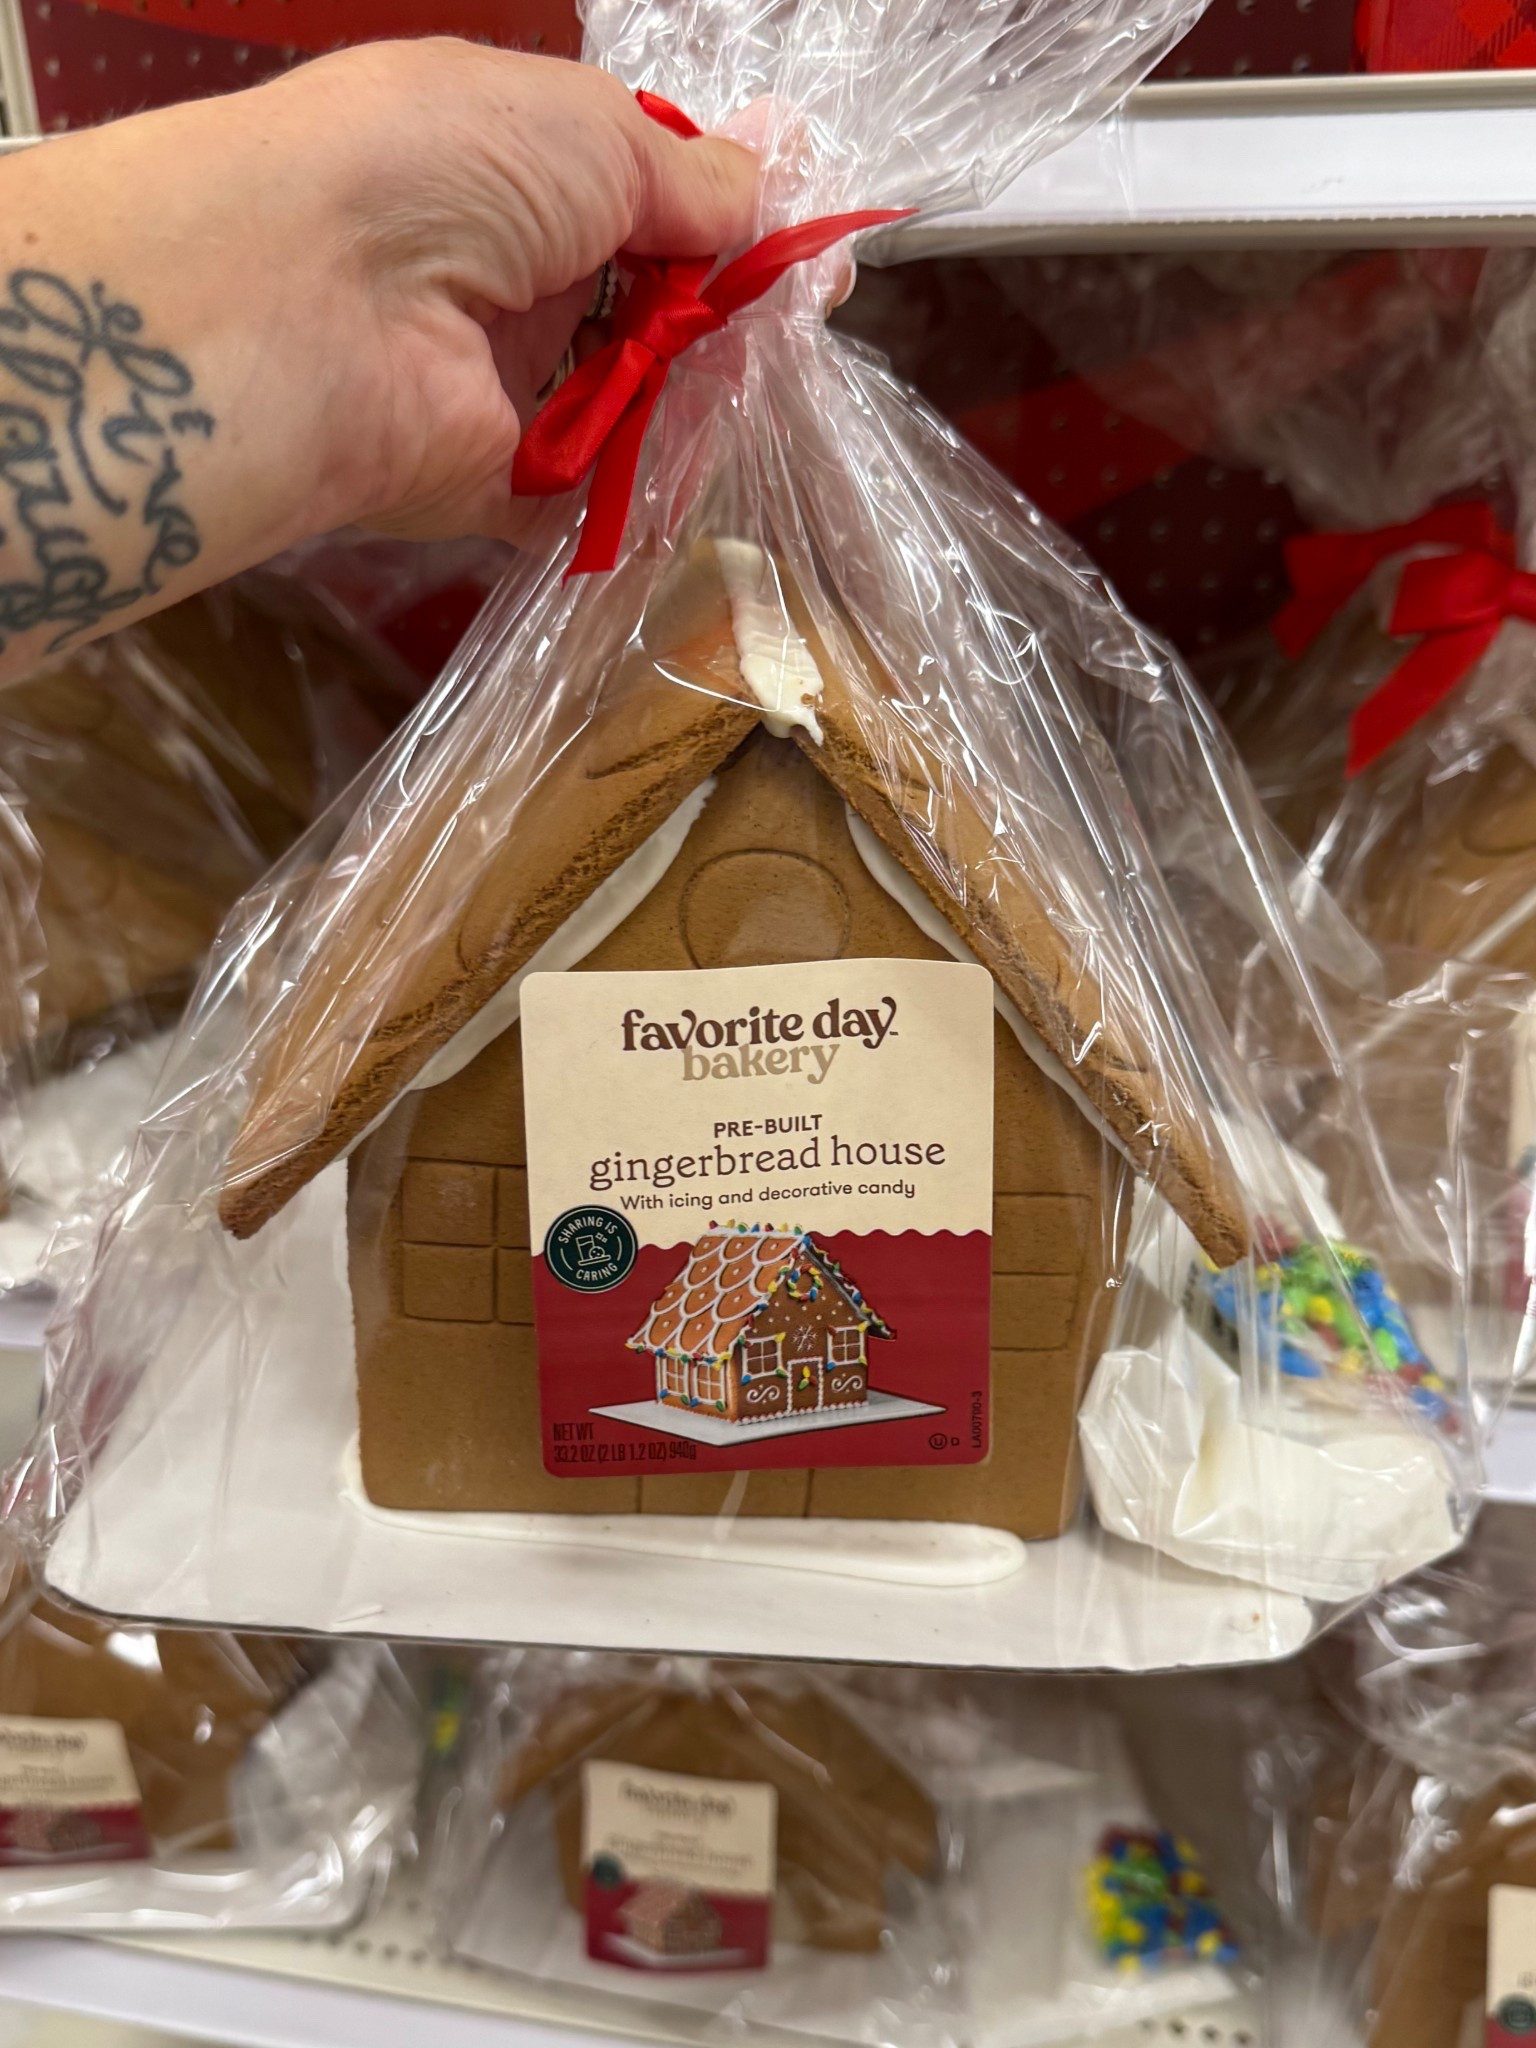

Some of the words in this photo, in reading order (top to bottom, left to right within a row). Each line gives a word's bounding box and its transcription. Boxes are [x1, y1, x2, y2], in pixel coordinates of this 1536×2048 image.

[620, 1006, 805, 1052] favorite
[812, 996, 897, 1049] day
[681, 1043, 841, 1085] bakery
[713, 1113, 823, 1138] PRE-BUILT
[588, 1137, 822, 1191] gingerbread
[830, 1134, 946, 1166] house
[620, 1194, 664, 1210] With
[669, 1192, 713, 1210] icing
[718, 1188, 753, 1205] and
[758, 1180, 853, 1201] decorative
[857, 1179, 916, 1199] candy
[558, 1216, 604, 1244] SHARING
[604, 1221, 618, 1235] IS
[576, 1262, 618, 1281] CARING
[553, 1423, 573, 1441] NET
[575, 1422, 595, 1440] WT
[554, 1443, 579, 1463] 33.2
[581, 1444, 596, 1462] OZ
[598, 1443, 610, 1463] (2
[612, 1443, 626, 1462] LB
[629, 1442, 647, 1461] 1.2
[649, 1441, 667, 1462] OZ)
